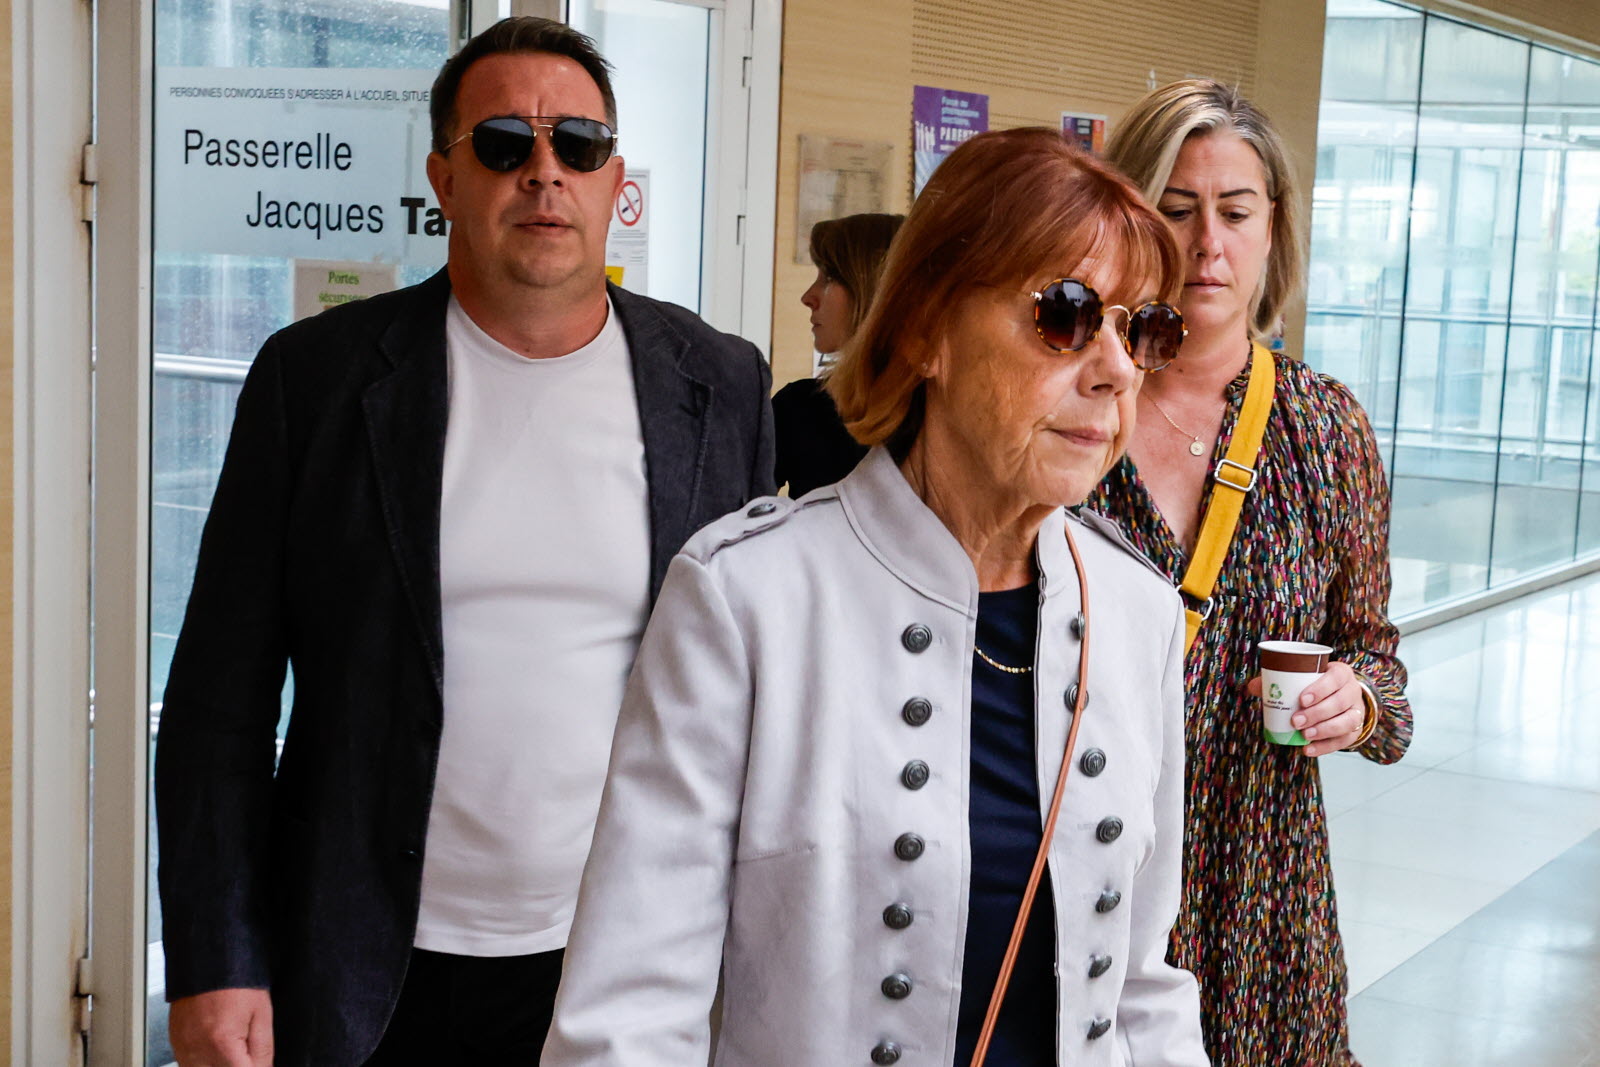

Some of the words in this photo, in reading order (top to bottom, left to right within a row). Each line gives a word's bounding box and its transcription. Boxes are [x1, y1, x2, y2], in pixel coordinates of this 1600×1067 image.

[169, 87, 222, 98] PERSONNES
[287, 88, 343, 100] S'ADRESSER
[354, 89, 400, 102] L'ACCUEIL
[184, 129, 352, 171] Passerelle
[246, 190, 384, 240] Jacques
[328, 271, 359, 285] Portes
